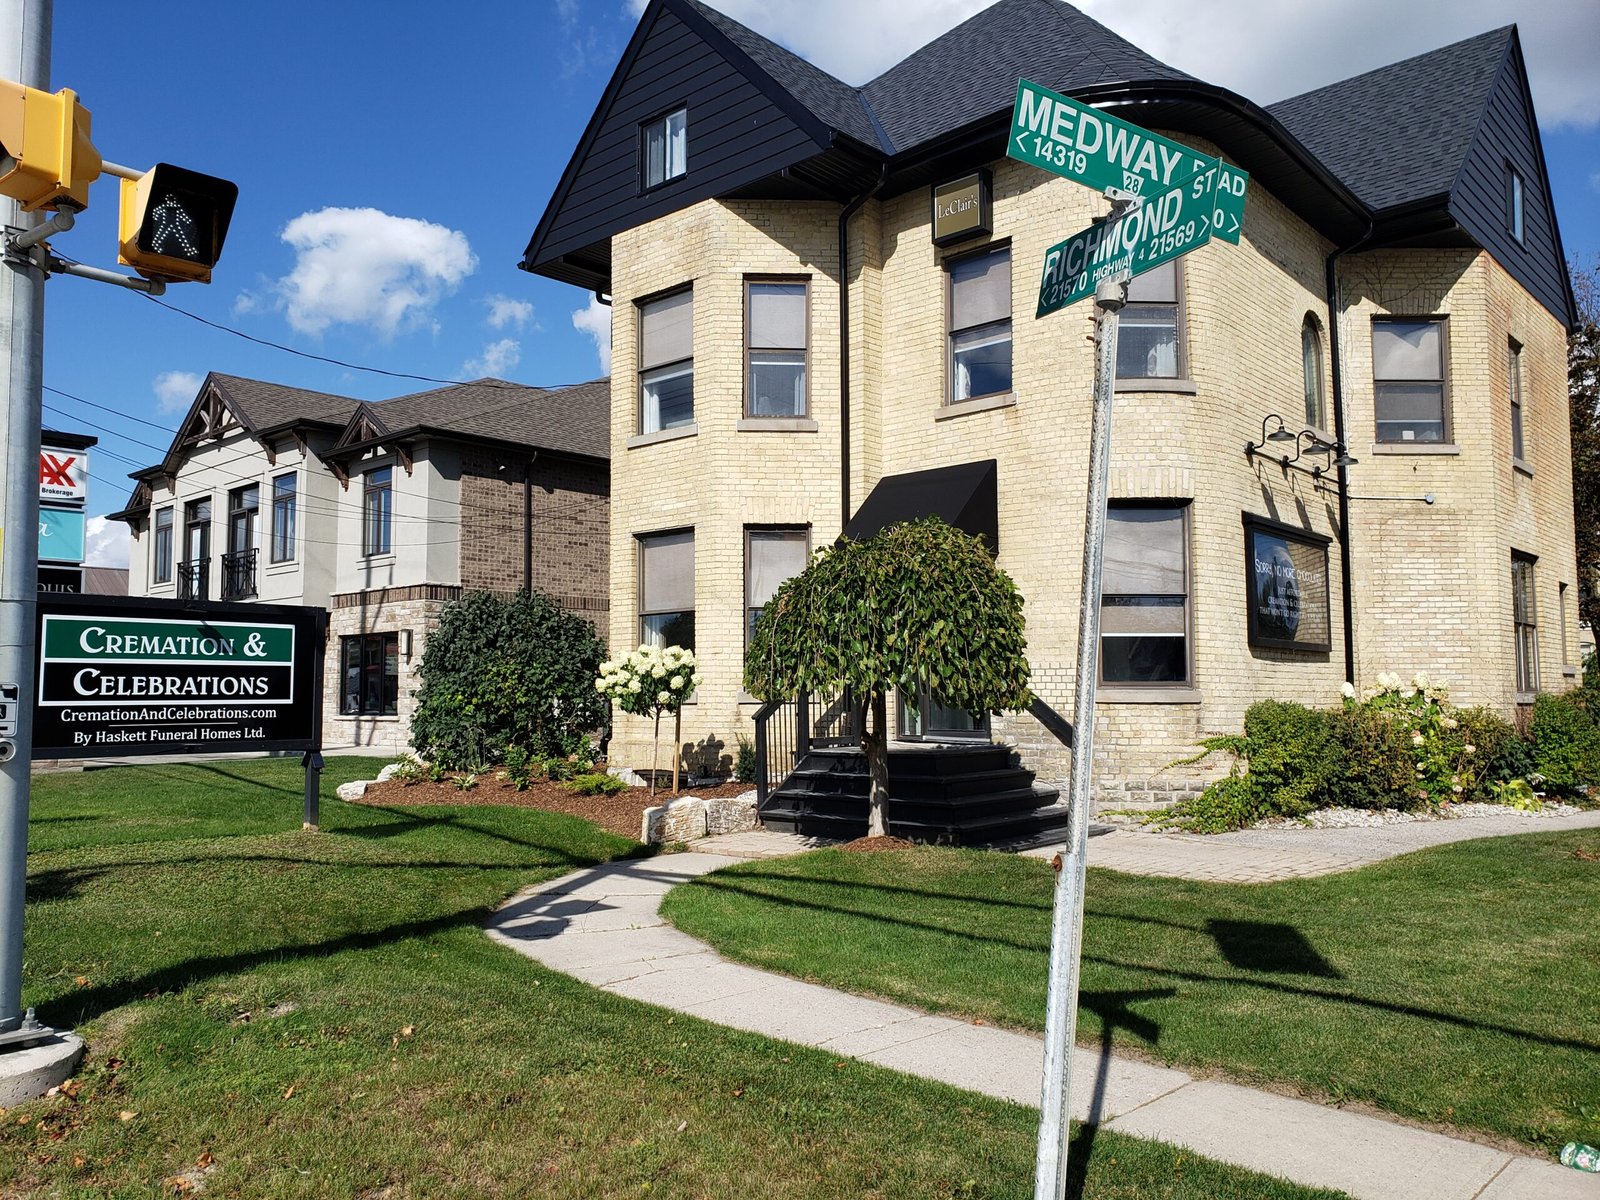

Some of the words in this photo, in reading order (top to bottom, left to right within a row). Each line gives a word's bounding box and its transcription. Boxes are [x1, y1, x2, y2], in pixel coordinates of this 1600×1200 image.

[1018, 88, 1182, 185] MEDWAY
[1193, 159, 1246, 197] AD
[1033, 137, 1087, 174] 14319
[1124, 175, 1140, 193] 28
[938, 194, 978, 219] LeClair's
[1043, 188, 1183, 289] RICHMOND
[1192, 168, 1218, 200] ST
[1148, 220, 1196, 261] 21569
[1092, 252, 1136, 281] HIGHWAY
[1138, 250, 1145, 261] 4
[1050, 273, 1087, 304] 21570
[41, 487, 74, 497] Brokerage
[79, 626, 235, 656] CREMATION
[243, 632, 268, 657] &
[73, 668, 269, 696] CELEBRATIONS
[60, 706, 278, 723] CremationAndCelebrations.com
[73, 731, 92, 747] By
[95, 730, 147, 743] Haskett
[150, 728, 198, 741] Funeral
[201, 727, 241, 740] Homes
[244, 726, 267, 739] Ltd.
